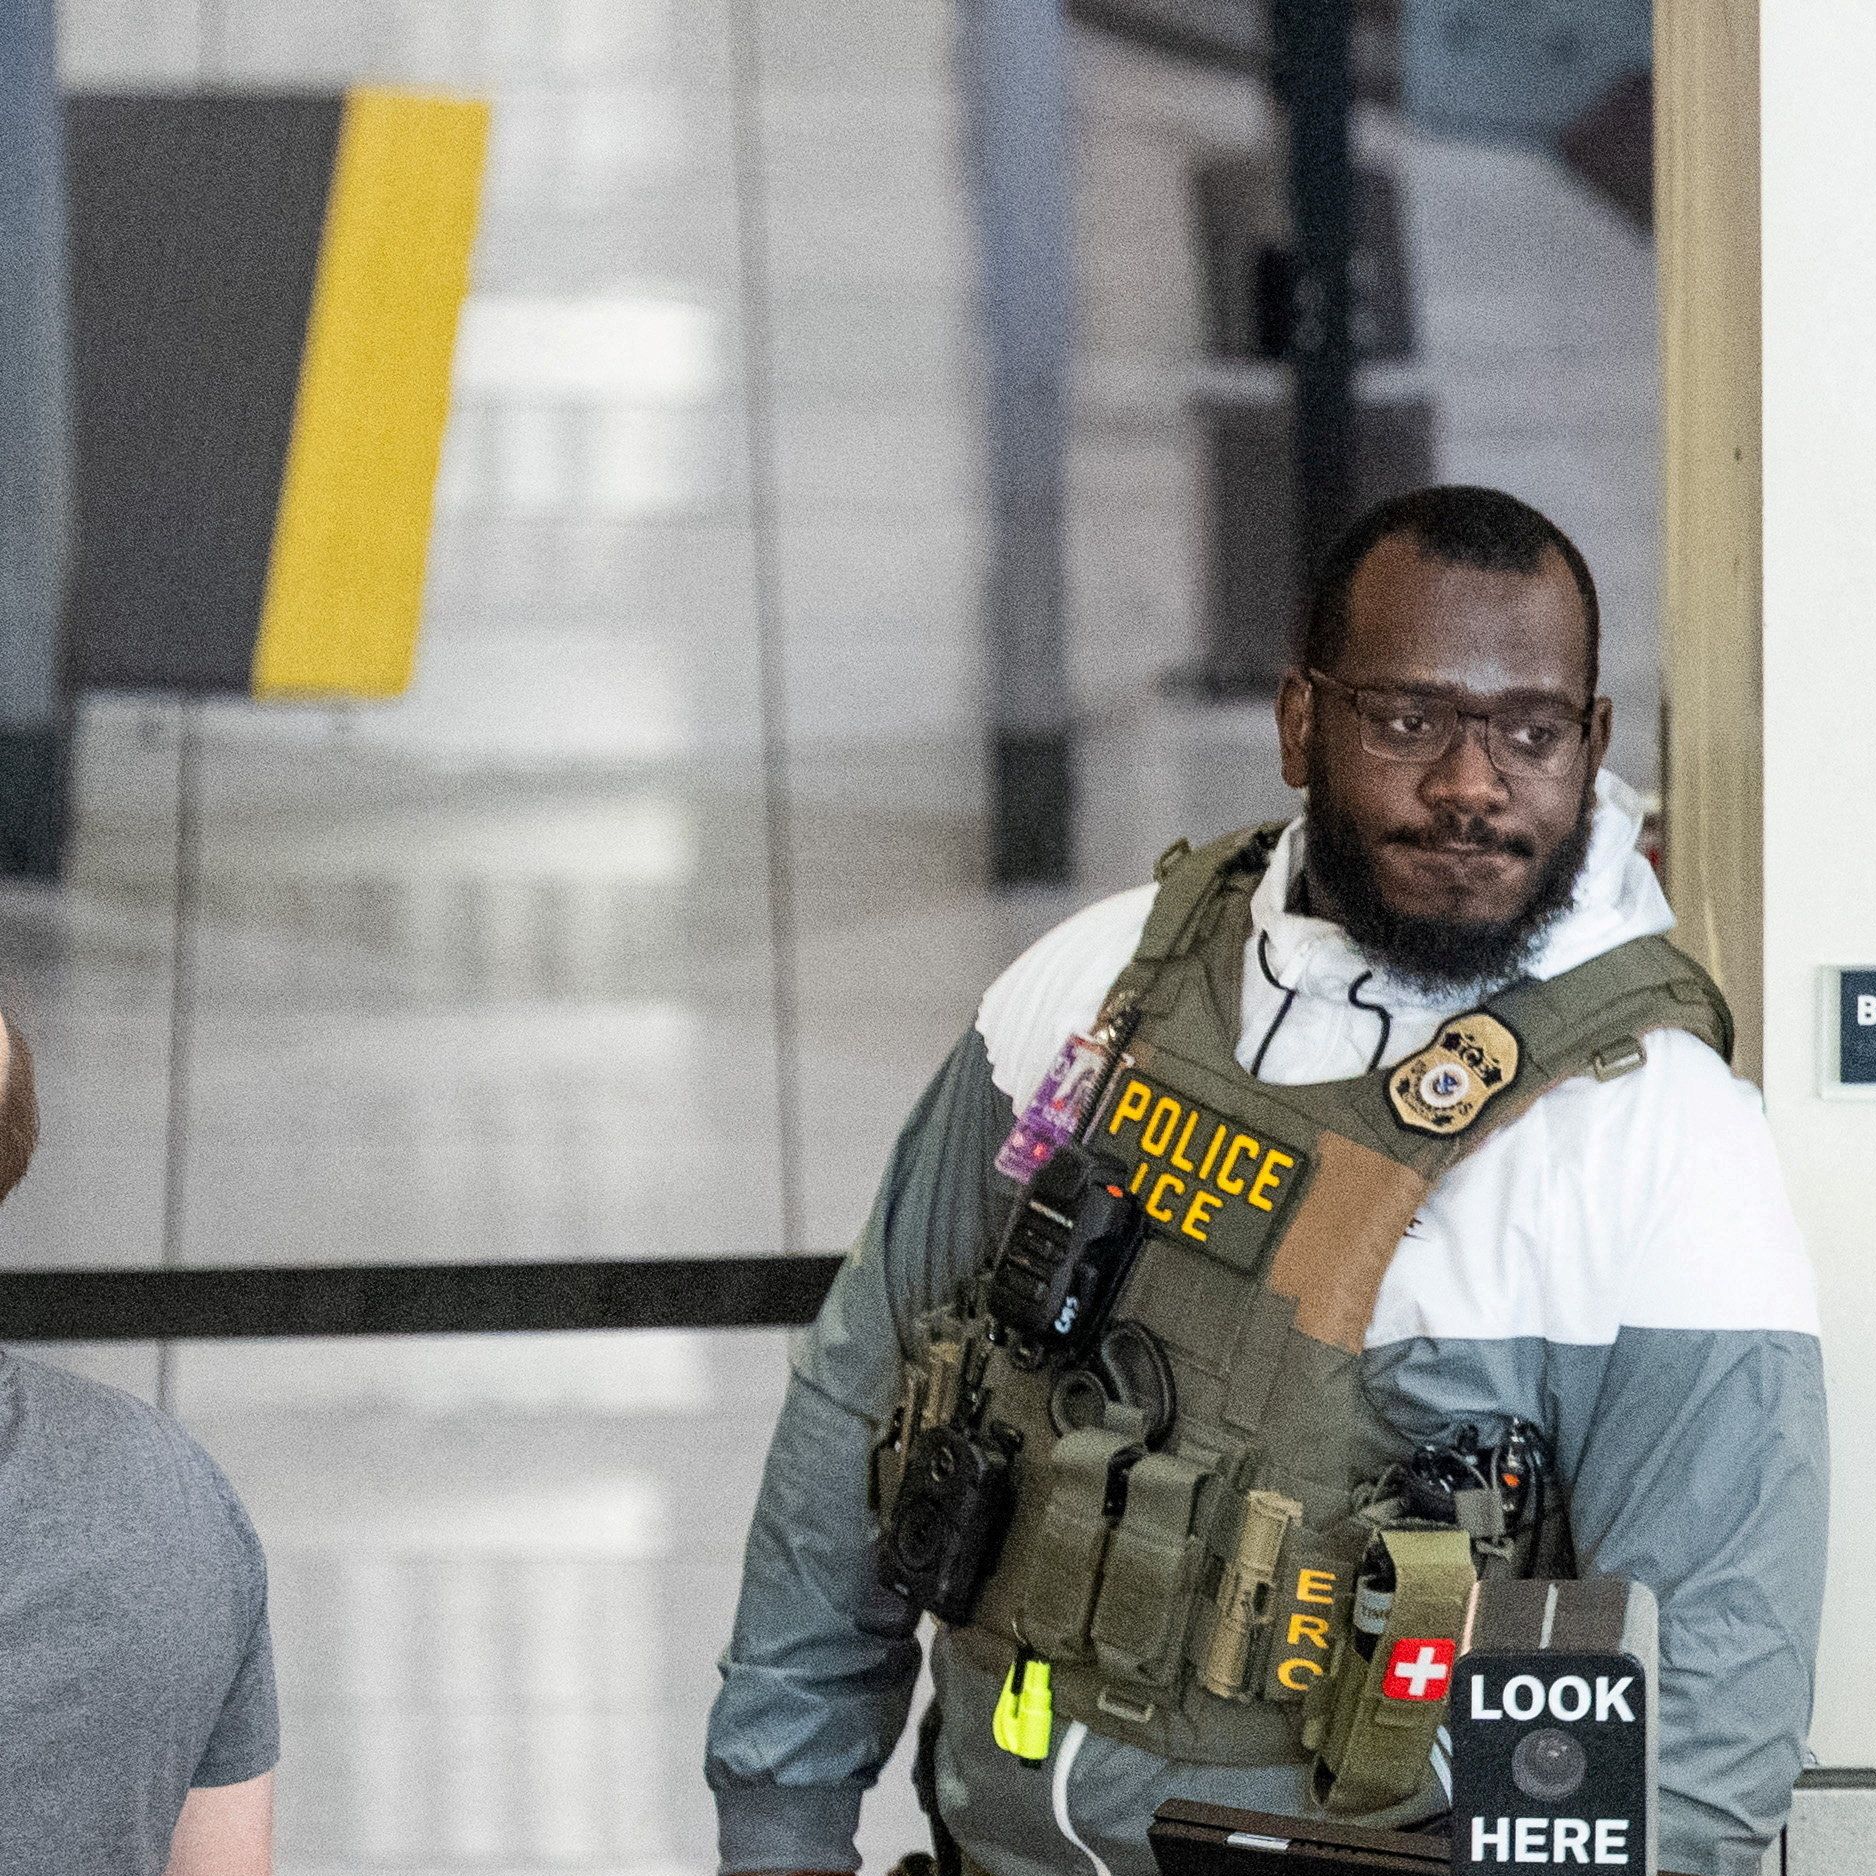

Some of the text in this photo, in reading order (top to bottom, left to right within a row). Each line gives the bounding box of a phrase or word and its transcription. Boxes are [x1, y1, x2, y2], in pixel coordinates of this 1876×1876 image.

[1109, 1081, 1295, 1213] POLICE
[1130, 1162, 1224, 1243] ICE
[1471, 1675, 1635, 1722] LOOK
[1471, 1818, 1629, 1865] HERE
